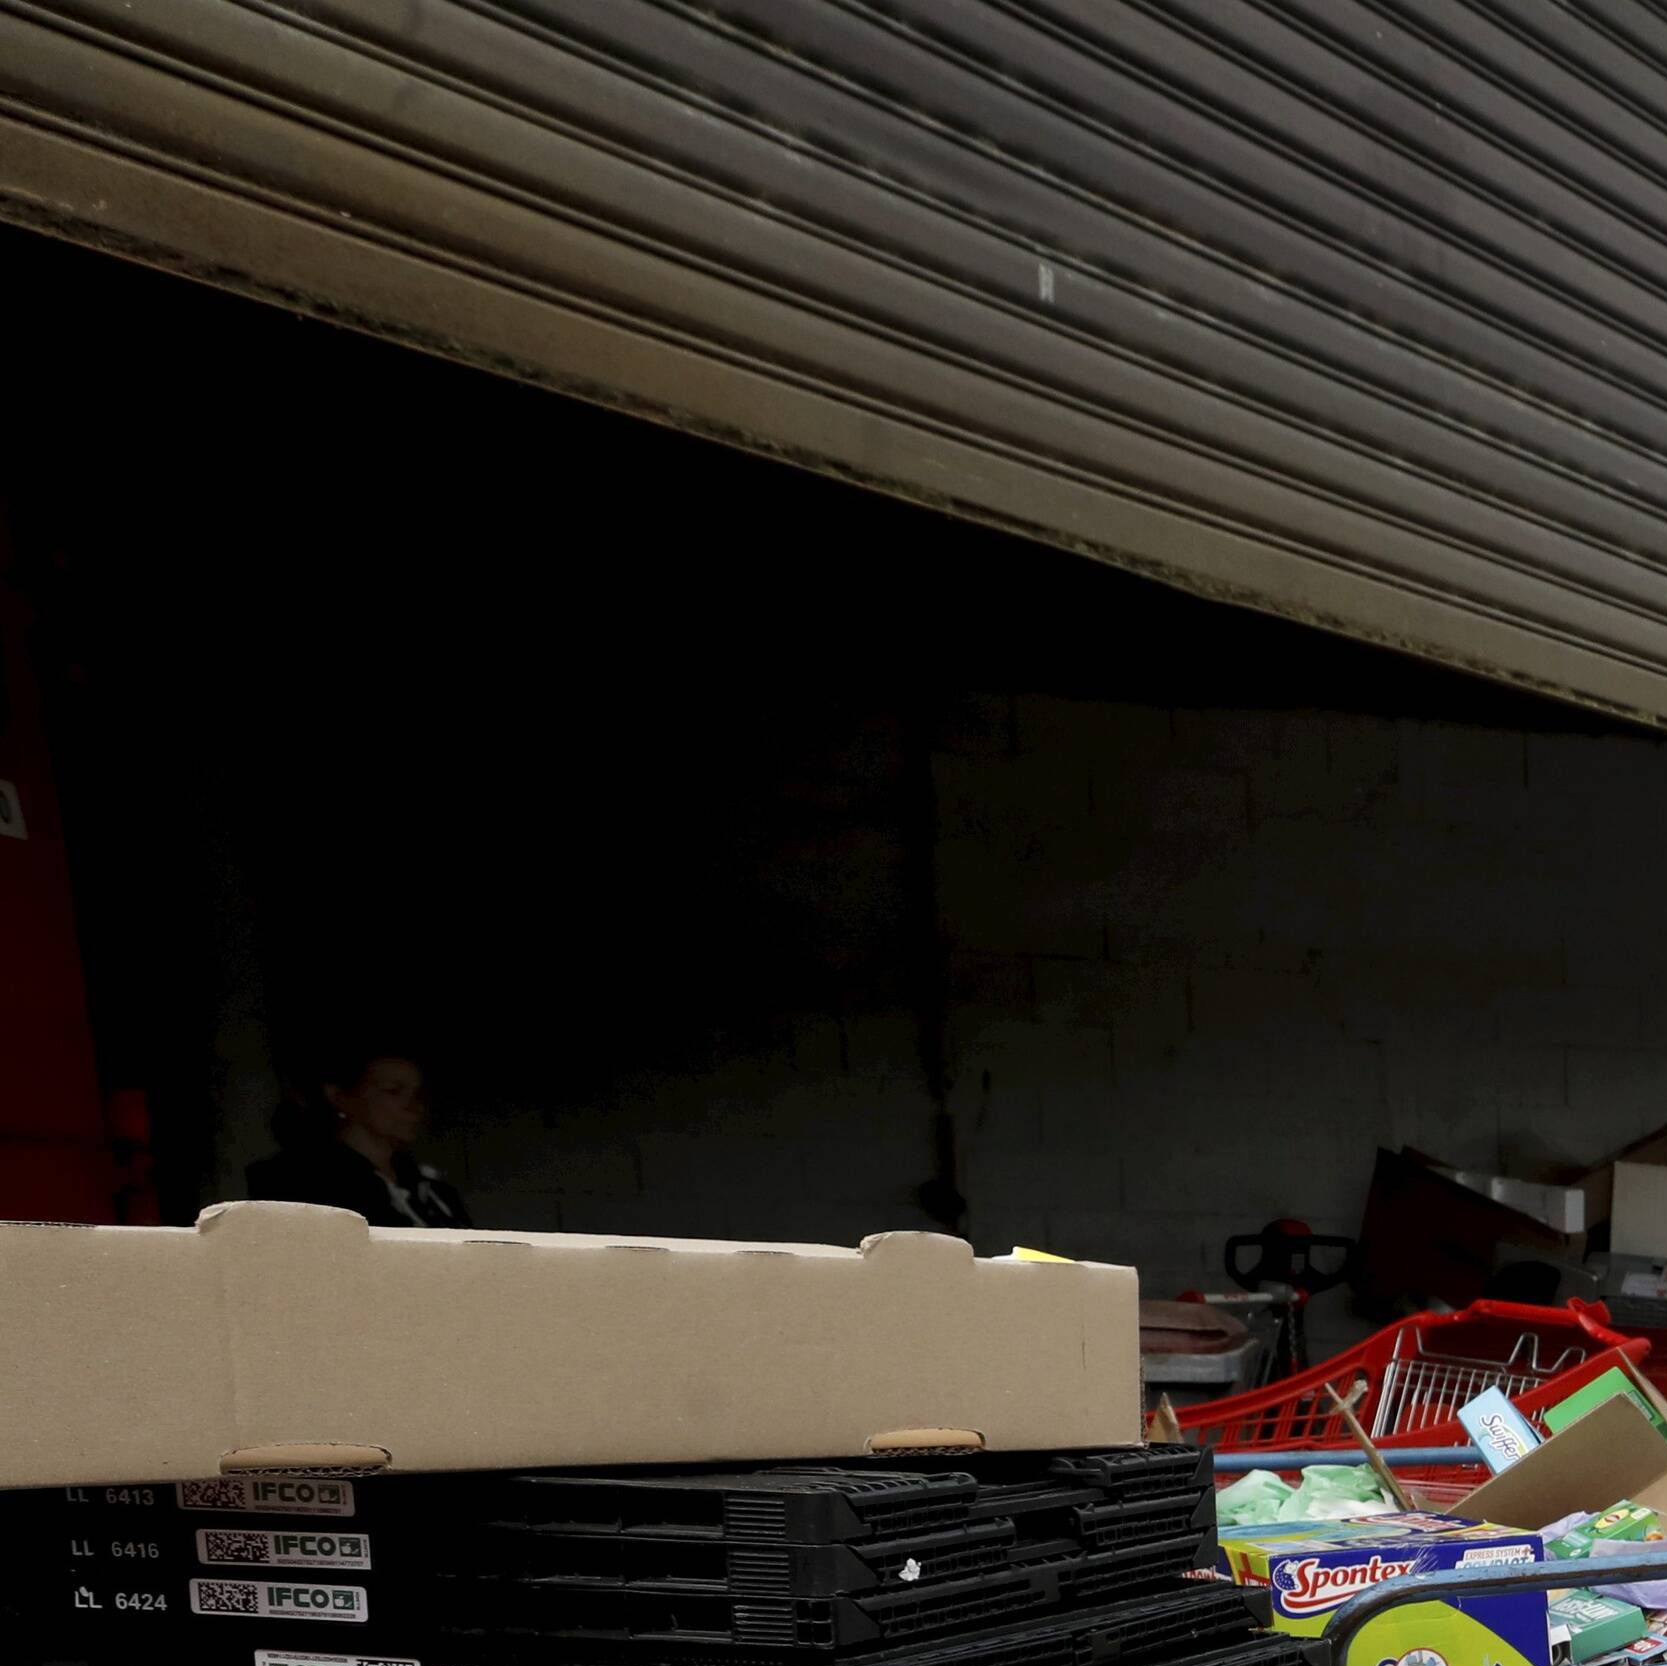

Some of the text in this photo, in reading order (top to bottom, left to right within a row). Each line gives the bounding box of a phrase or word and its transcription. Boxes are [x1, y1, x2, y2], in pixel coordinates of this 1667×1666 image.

[1480, 1414, 1521, 1461] Swiffer
[105, 1487, 154, 1505] 6413
[253, 1482, 313, 1502] IFCO
[71, 1540, 159, 1559] LL 6416
[274, 1535, 335, 1555] IFCO
[1464, 1547, 1522, 1561] EXPRESS SYSTEM
[1289, 1553, 1412, 1600] Spontex
[74, 1590, 168, 1611] LL 6424
[267, 1586, 329, 1608] IFCO
